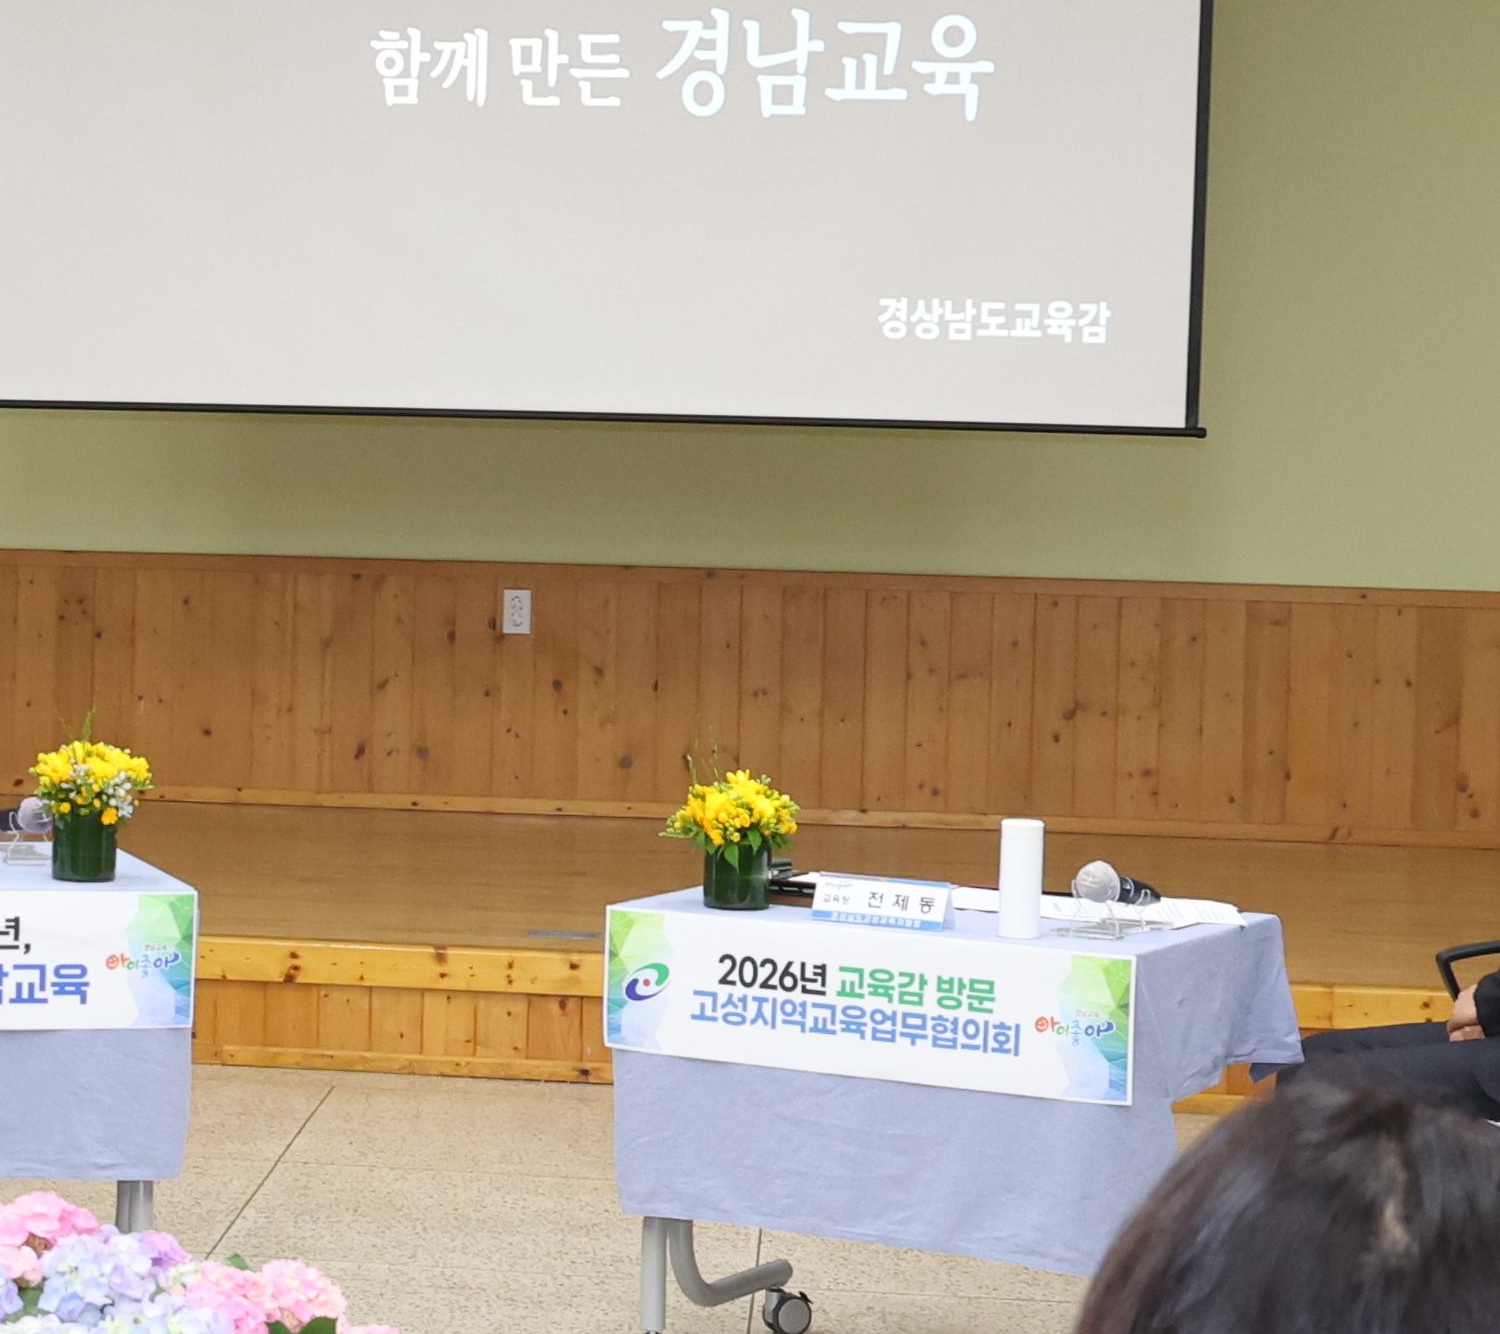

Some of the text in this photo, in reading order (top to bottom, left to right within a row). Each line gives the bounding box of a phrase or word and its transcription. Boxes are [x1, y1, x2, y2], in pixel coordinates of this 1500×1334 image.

[370, 8, 994, 121] 함께 만든 경남교육
[876, 296, 1111, 344] 경상남도교육감
[105, 951, 181, 979] 아이좋아
[718, 954, 996, 1014] 2026년 교육감 방문
[690, 989, 1021, 1057] 고성지역교육업무협의회
[1034, 1015, 1115, 1047] 아이좋아
